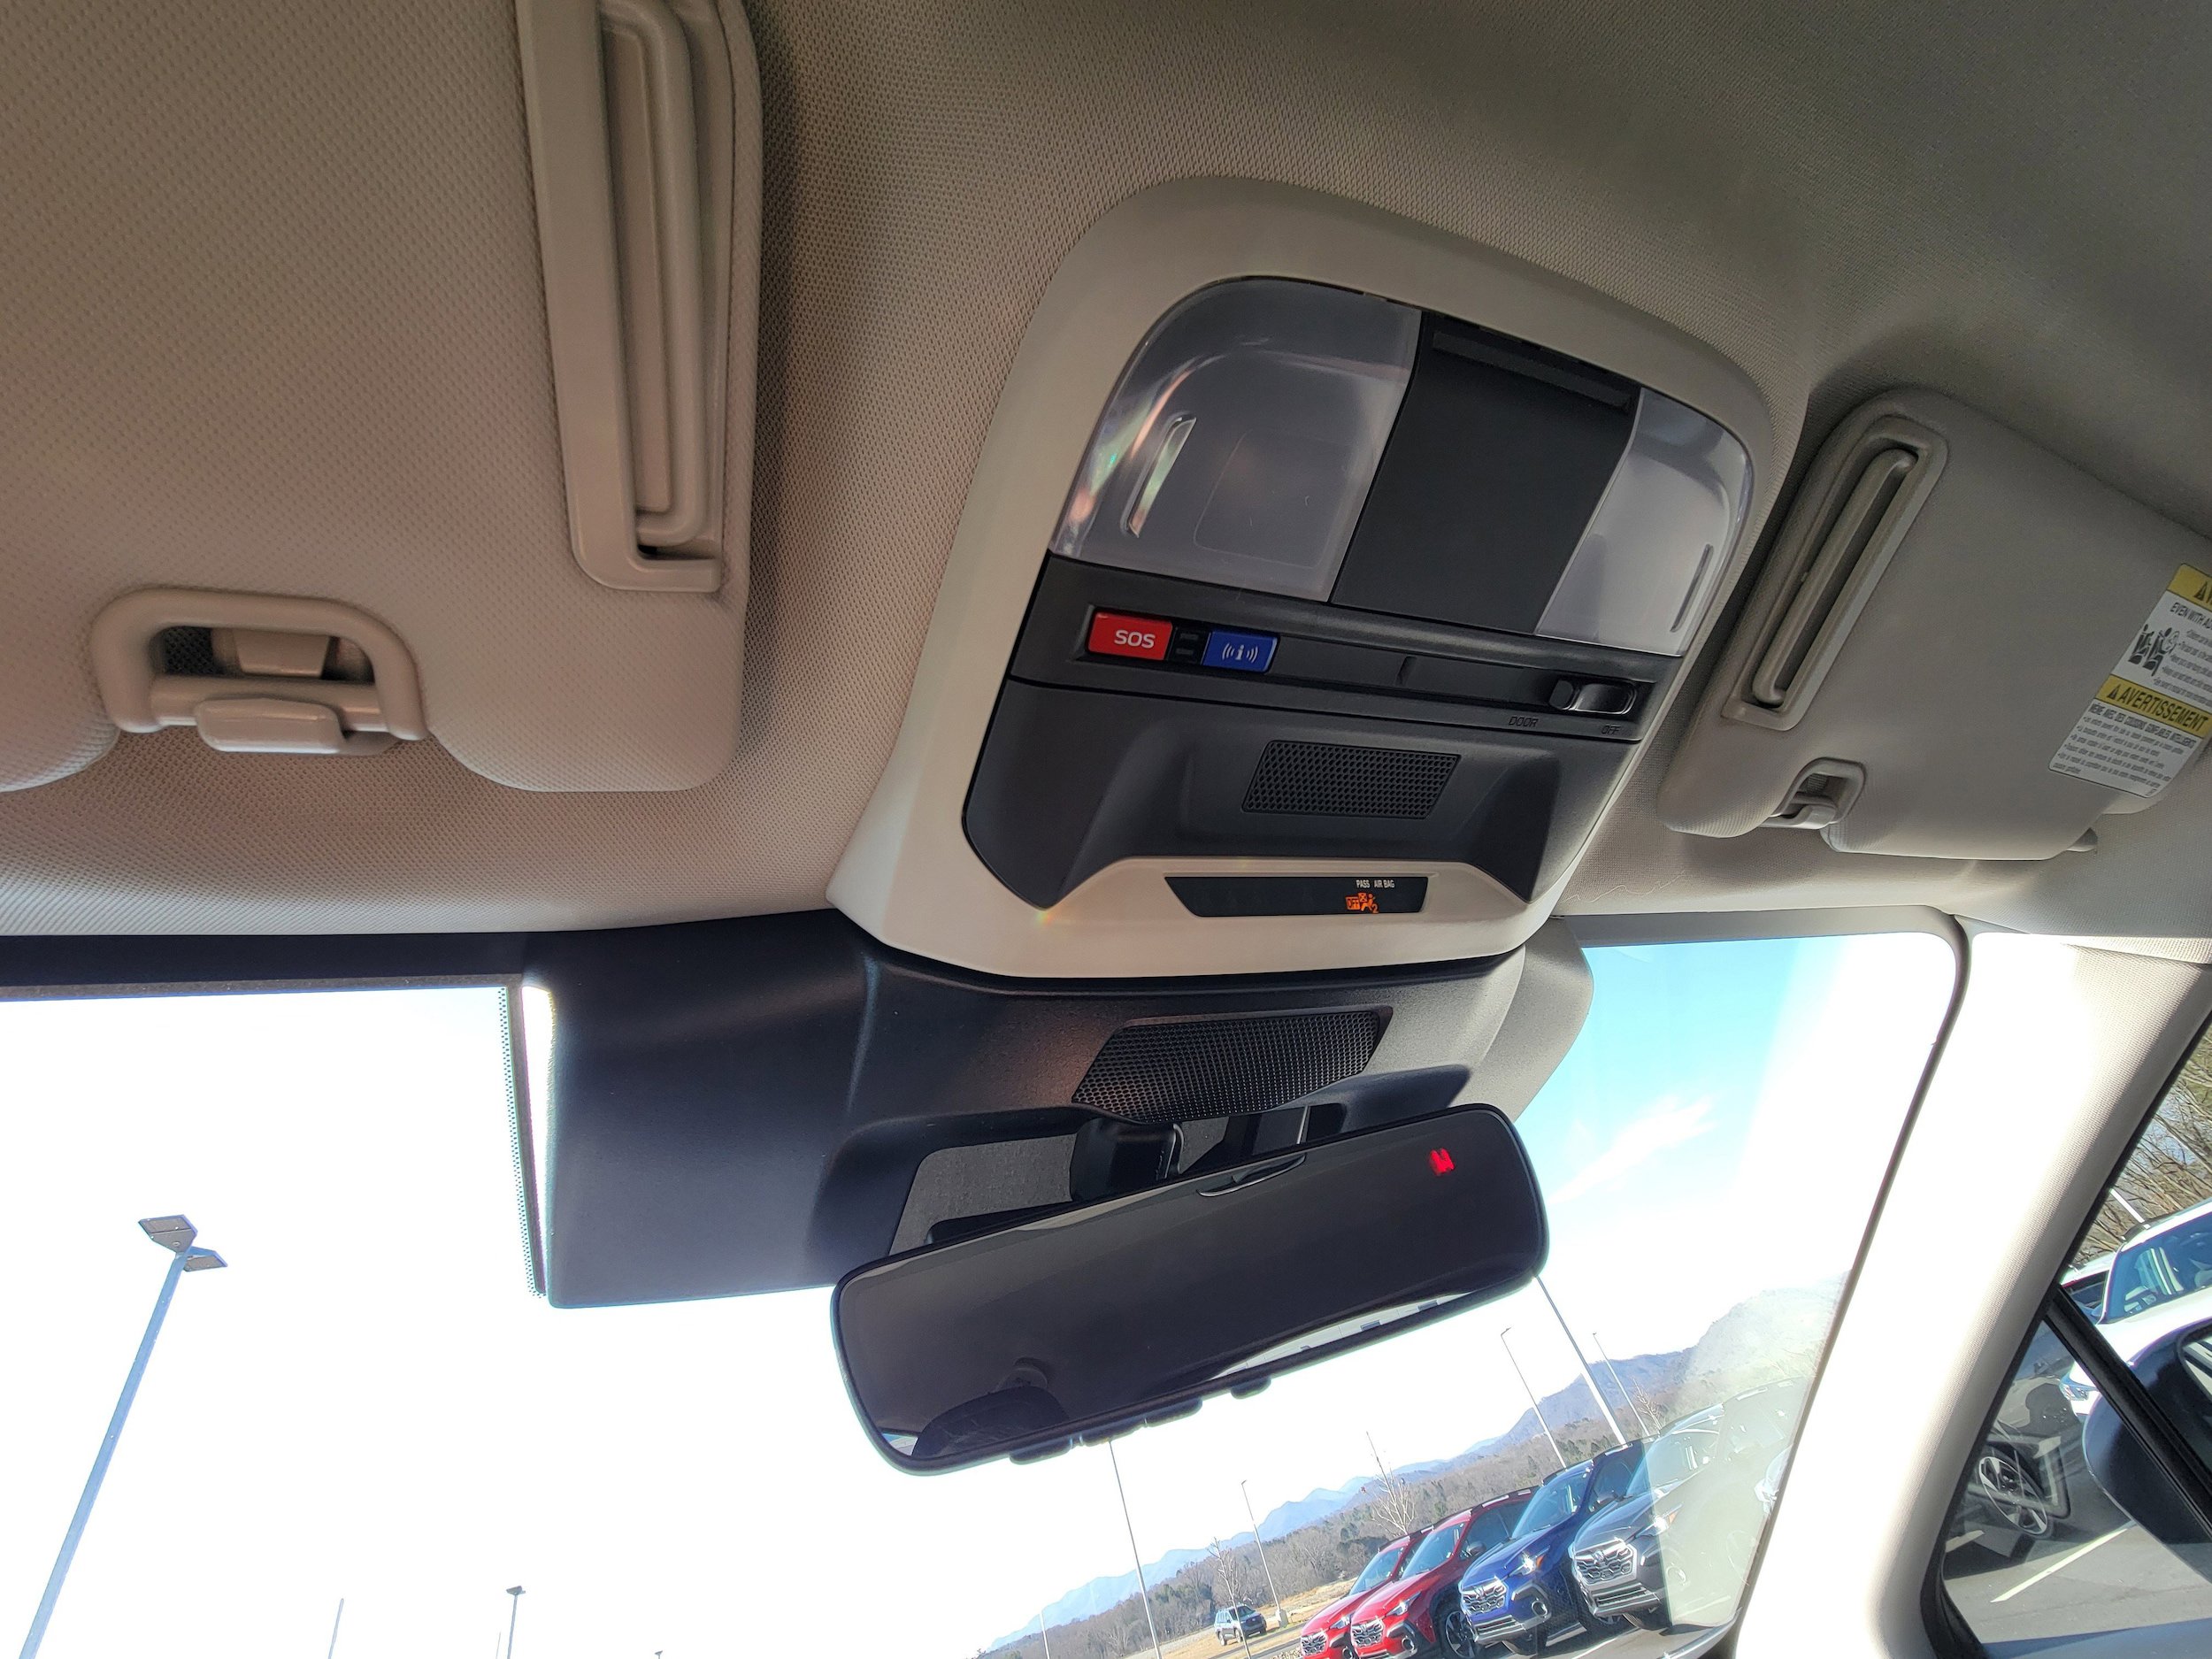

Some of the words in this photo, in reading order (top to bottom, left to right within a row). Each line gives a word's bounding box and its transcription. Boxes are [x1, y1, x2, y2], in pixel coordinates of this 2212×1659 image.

[2170, 602, 2191, 618] EVEN
[1114, 629, 1156, 649] SOS
[2117, 687, 2209, 732] AVERTISSEMENT
[1508, 715, 1540, 728] DOOR
[1601, 725, 1622, 734] OFF
[1356, 879, 1371, 888] PASS
[1374, 879, 1383, 888] AIR
[1383, 879, 1395, 888] BAG
